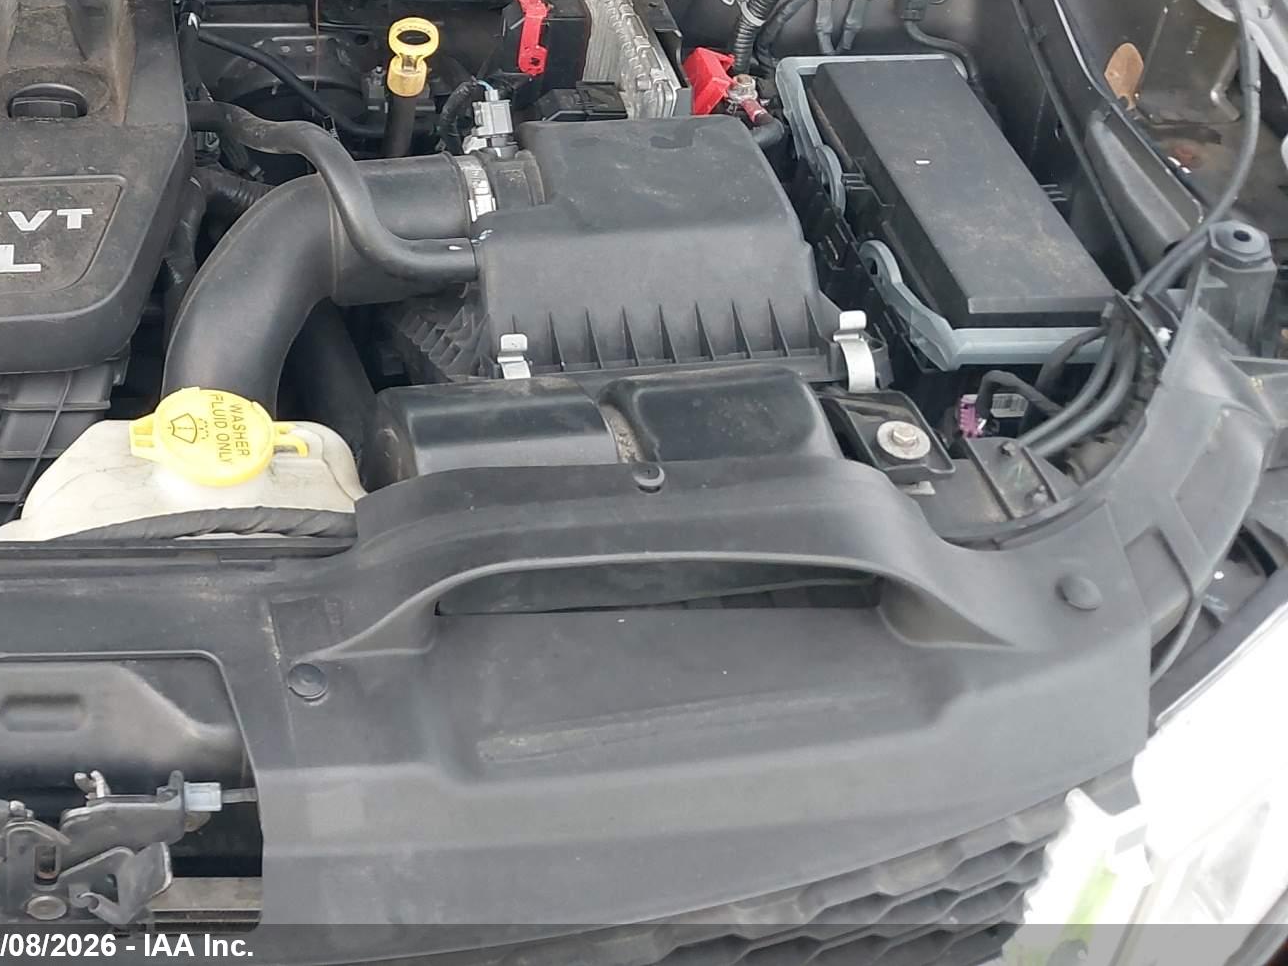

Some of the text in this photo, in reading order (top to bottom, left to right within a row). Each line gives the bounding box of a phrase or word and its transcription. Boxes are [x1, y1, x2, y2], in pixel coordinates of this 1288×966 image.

[211, 394, 232, 464] FLUID ONLY
[230, 404, 250, 456] WASHER
